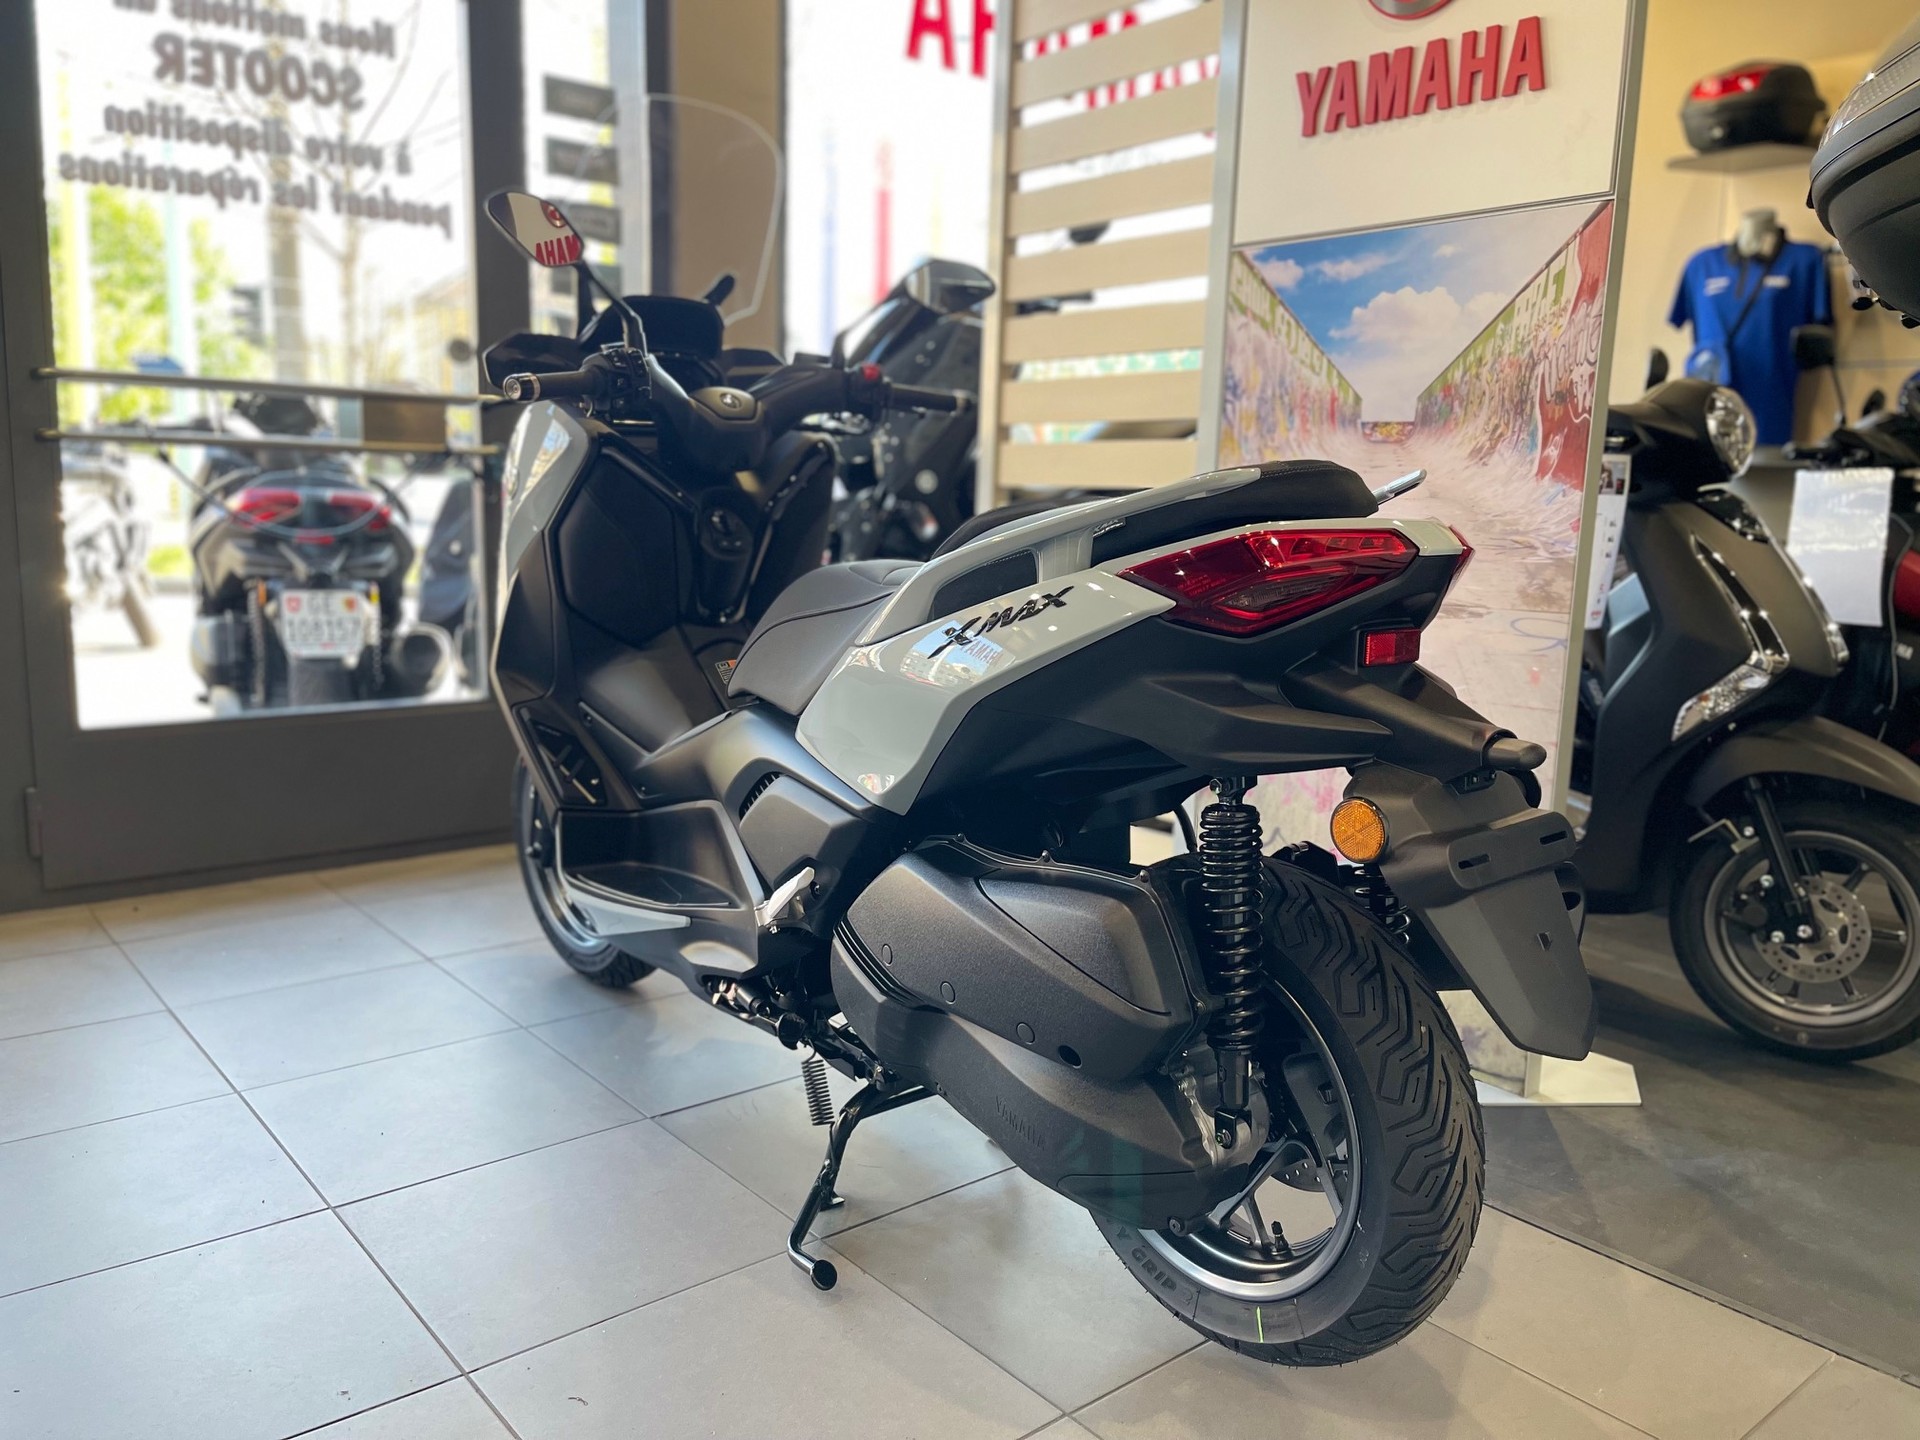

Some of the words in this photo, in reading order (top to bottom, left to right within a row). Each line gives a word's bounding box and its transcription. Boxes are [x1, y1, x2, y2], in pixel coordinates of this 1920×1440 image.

[1296, 16, 1545, 137] YAMAHA
[995, 1095, 1045, 1151] YAMAHA
[1132, 1247, 1177, 1292] GRIP
